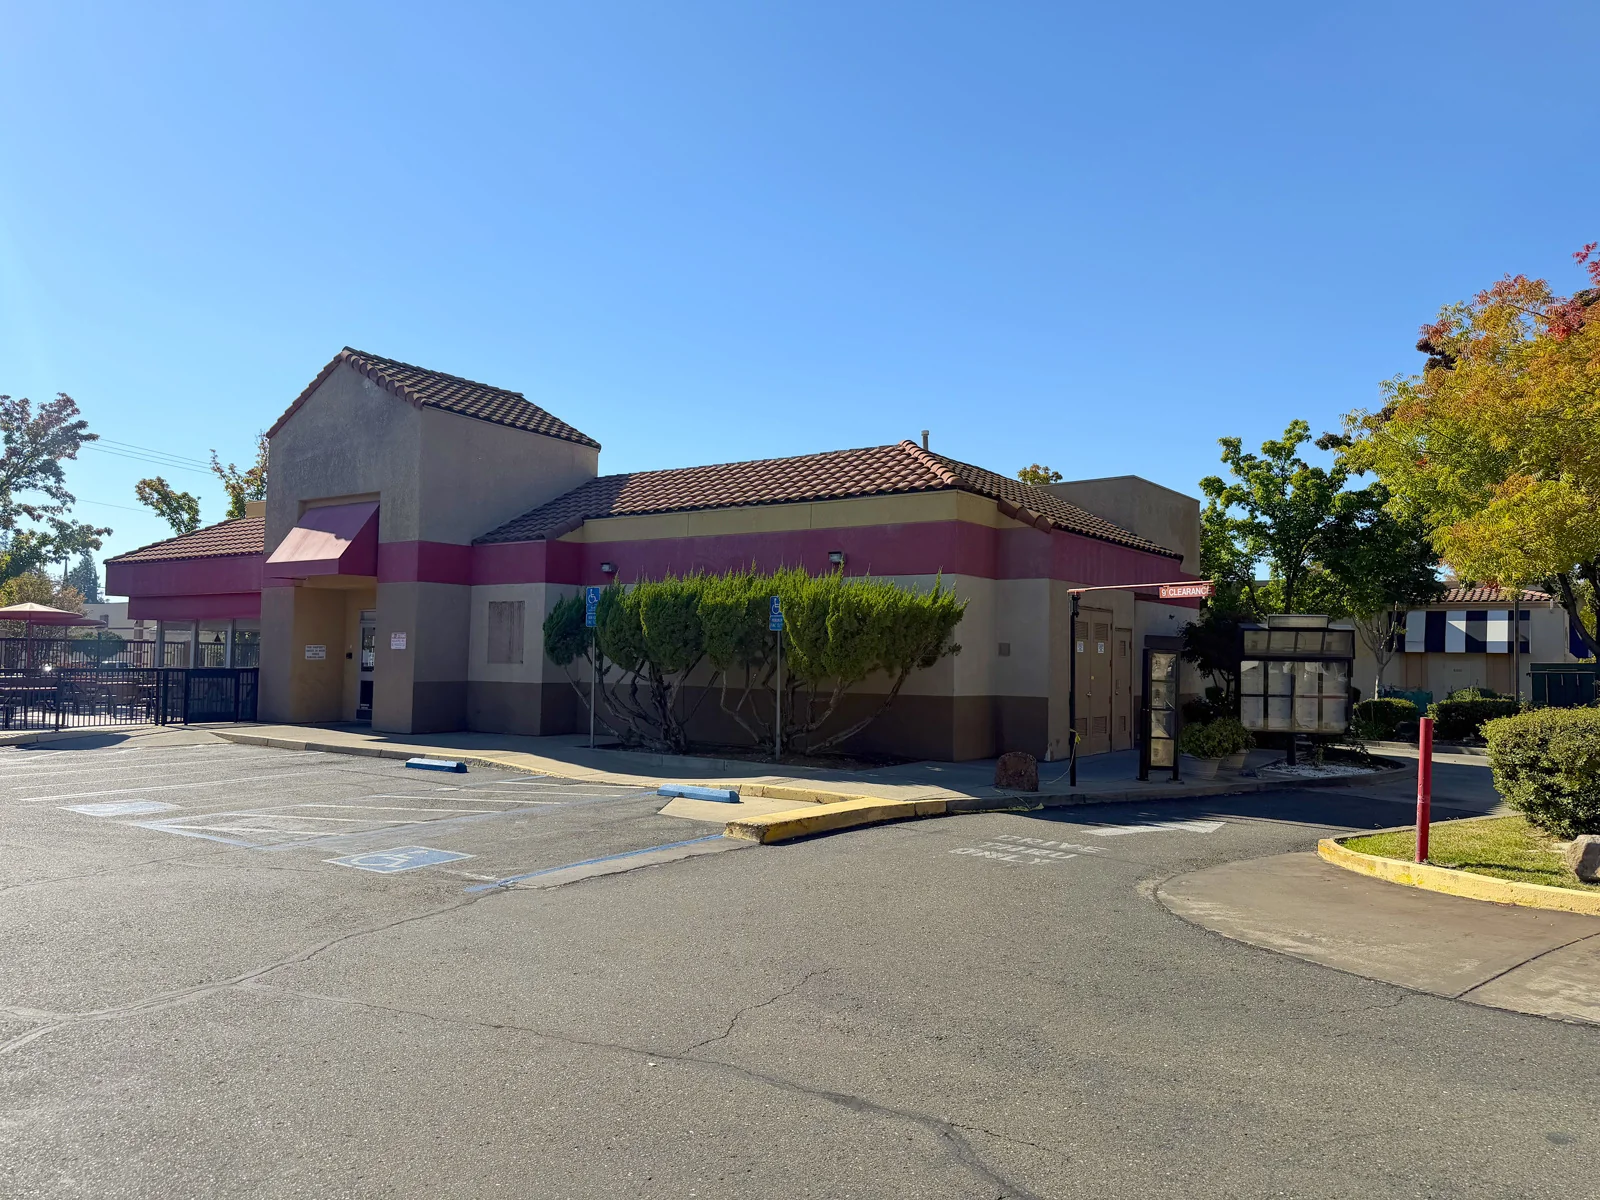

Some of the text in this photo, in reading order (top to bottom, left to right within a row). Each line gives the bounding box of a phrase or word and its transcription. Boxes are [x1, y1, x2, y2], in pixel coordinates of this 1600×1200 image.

[1168, 586, 1212, 596] CLEARANCE
[978, 841, 1080, 859] THRU
[992, 834, 1110, 853] DRIVE
[948, 847, 1055, 865] ONLY
